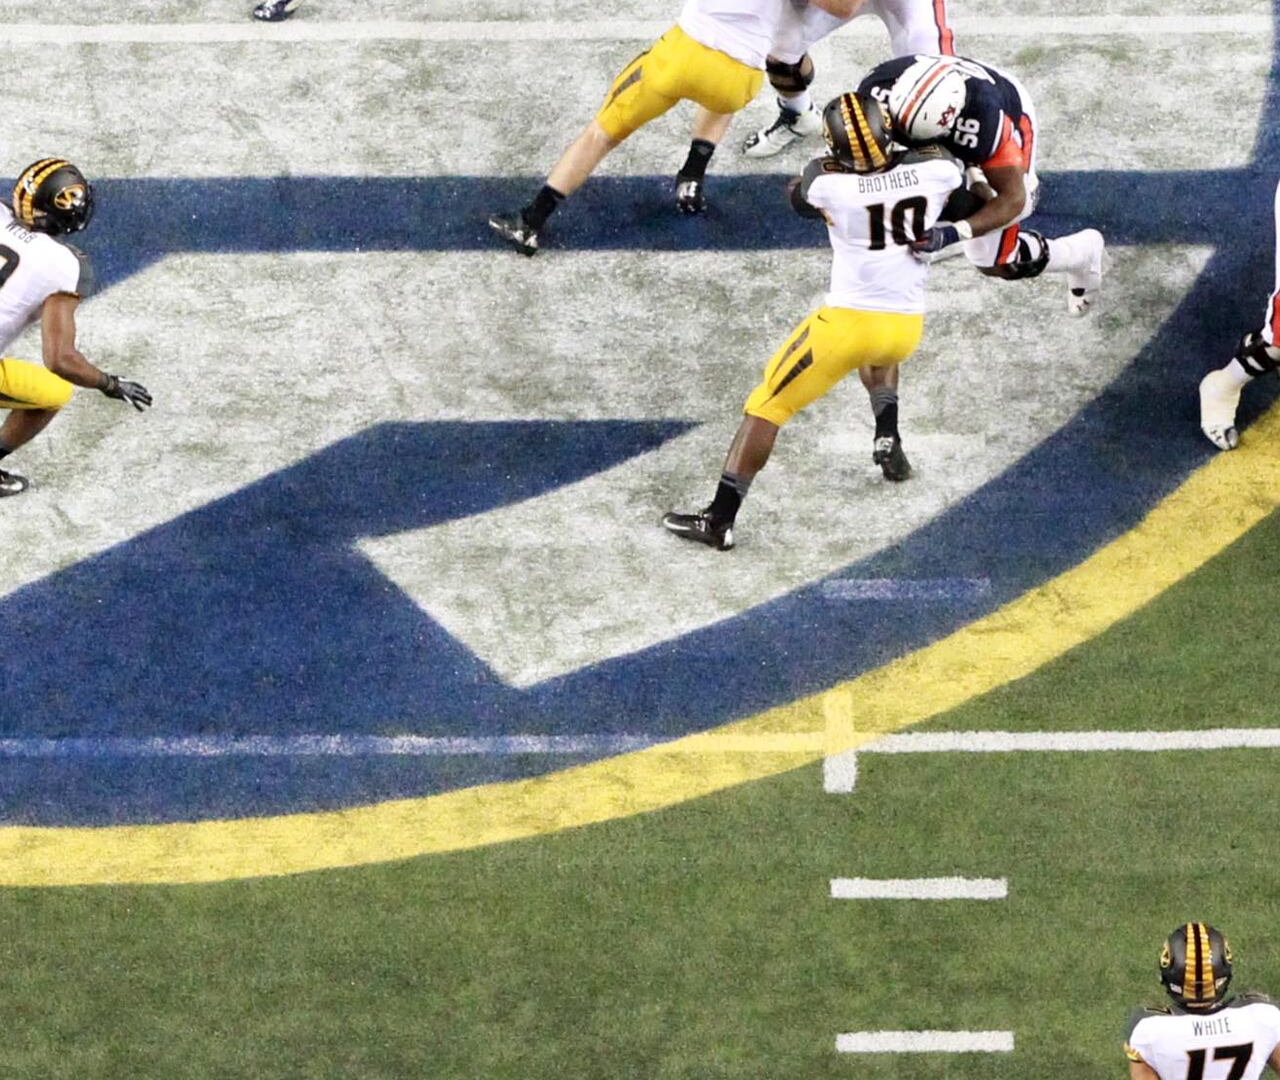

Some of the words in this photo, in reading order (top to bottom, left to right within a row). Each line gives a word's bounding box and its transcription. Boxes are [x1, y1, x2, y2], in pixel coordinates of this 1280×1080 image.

[954, 118, 980, 148] 56
[858, 169, 920, 194] BROTHERS
[866, 195, 928, 250] 10
[1192, 1017, 1232, 1036] WHITE
[1186, 1041, 1254, 1080] 17
